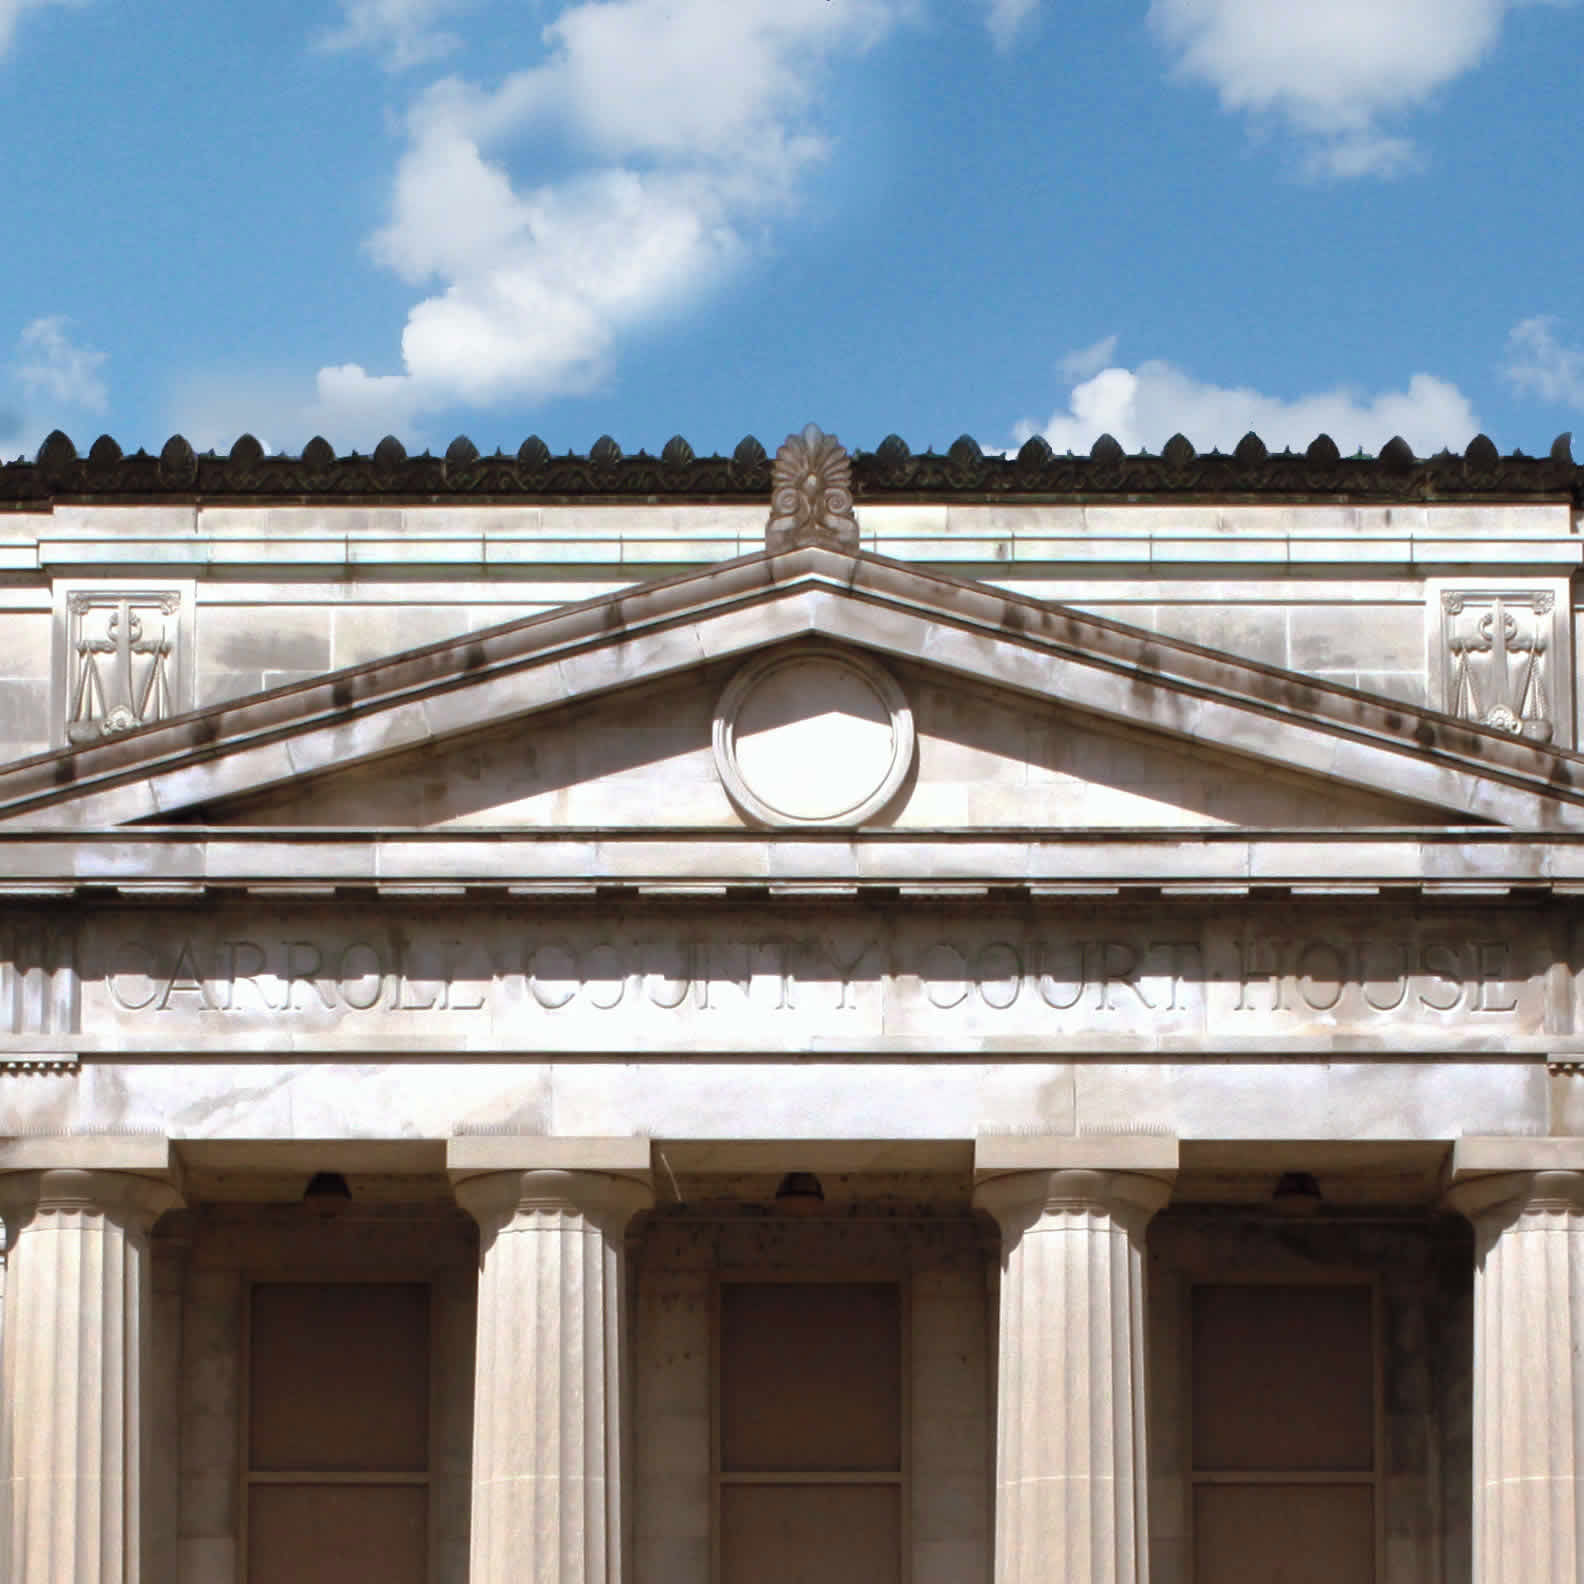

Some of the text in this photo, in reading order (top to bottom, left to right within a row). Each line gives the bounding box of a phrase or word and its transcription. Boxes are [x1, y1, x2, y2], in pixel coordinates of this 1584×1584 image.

[105, 940, 1519, 1011] CARROLL COUNTY COURT HOUSE
